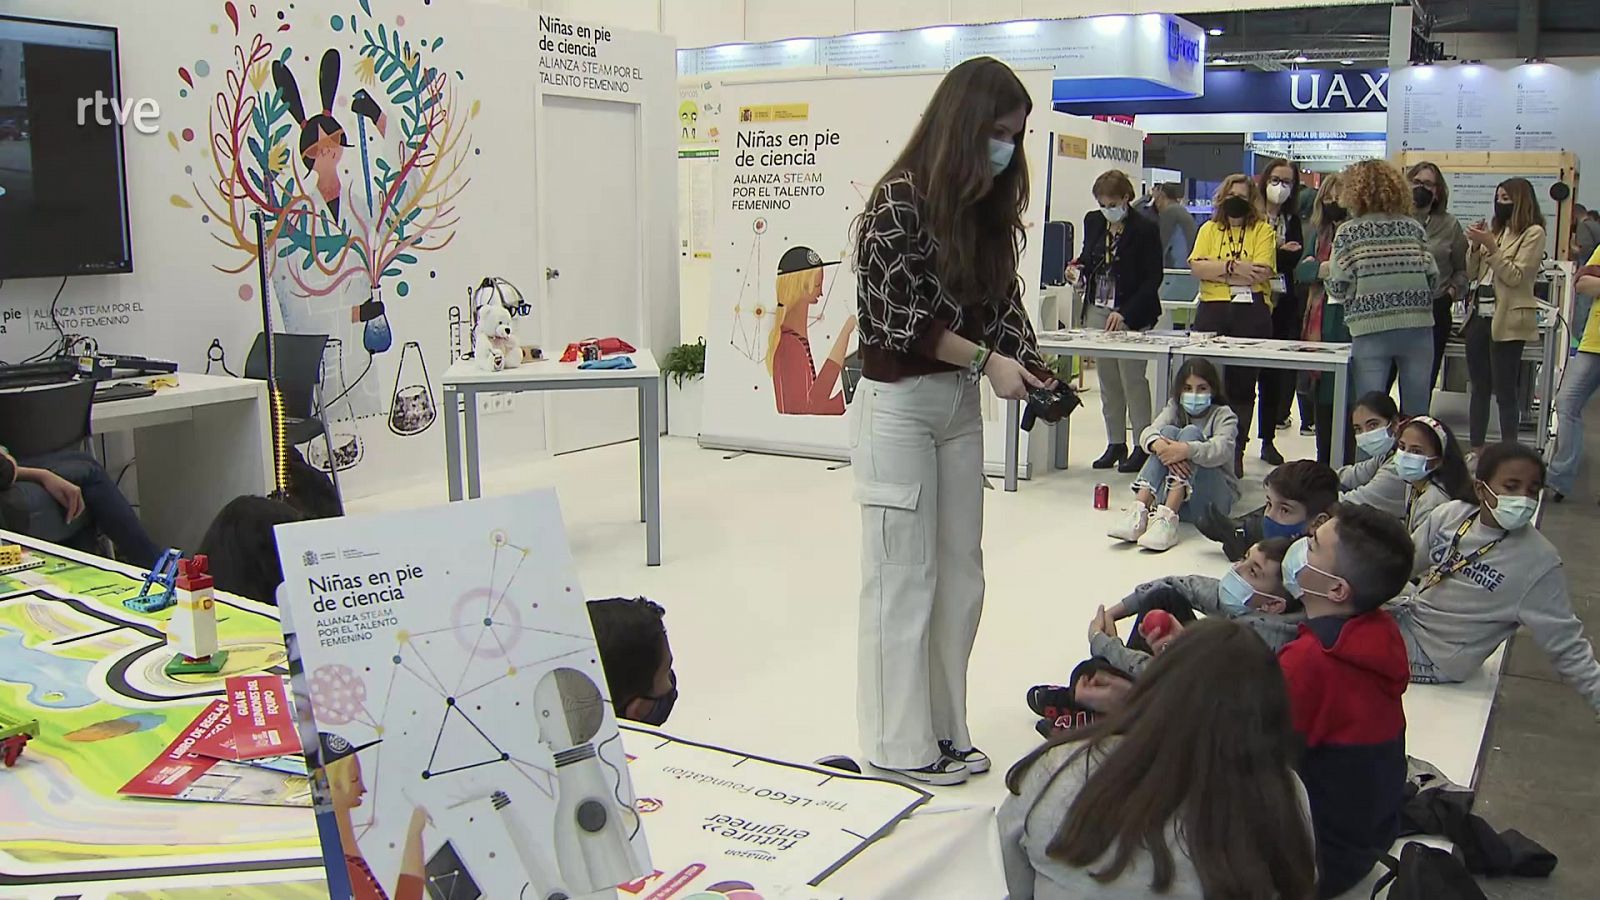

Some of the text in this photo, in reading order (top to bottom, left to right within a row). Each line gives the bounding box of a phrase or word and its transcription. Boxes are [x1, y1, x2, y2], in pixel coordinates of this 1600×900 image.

[539, 14, 611, 44] Niñas en pie
[539, 35, 597, 57] de ciencia
[539, 56, 643, 80] ALIANZA STEAM POR EL
[539, 71, 630, 93] TALENTO FEMENINO
[1290, 72, 1390, 110] UAX
[736, 128, 840, 151] Niñas en pie
[735, 150, 755, 166] de
[760, 149, 816, 166] ciencia
[1091, 143, 1132, 162] LABORATORIO
[733, 172, 822, 184] ALIANZA STEAM
[733, 186, 825, 197] POR EL TALENTO
[732, 199, 791, 210] FEMENINO
[3, 308, 21, 323] pie
[78, 305, 111, 316] STEAM
[112, 303, 131, 313] POR
[133, 302, 144, 312] EL
[80, 315, 130, 327] FEMENINO
[308, 564, 424, 595] Niñas en pie
[313, 586, 405, 613] de ciencia
[316, 608, 393, 628] ALIANZA STEAM
[318, 617, 398, 638] POR EL TALENTO
[320, 631, 373, 647] FEMENINO
[235, 690, 246, 700] DE
[263, 690, 279, 715] EQUIPO
[199, 702, 230, 729] REGLAS
[193, 726, 206, 739] DE
[169, 737, 196, 759] LIBRO
[662, 766, 849, 813] The LEGO Foundation
[704, 813, 811, 839] engineer
[724, 849, 776, 863] amazon
